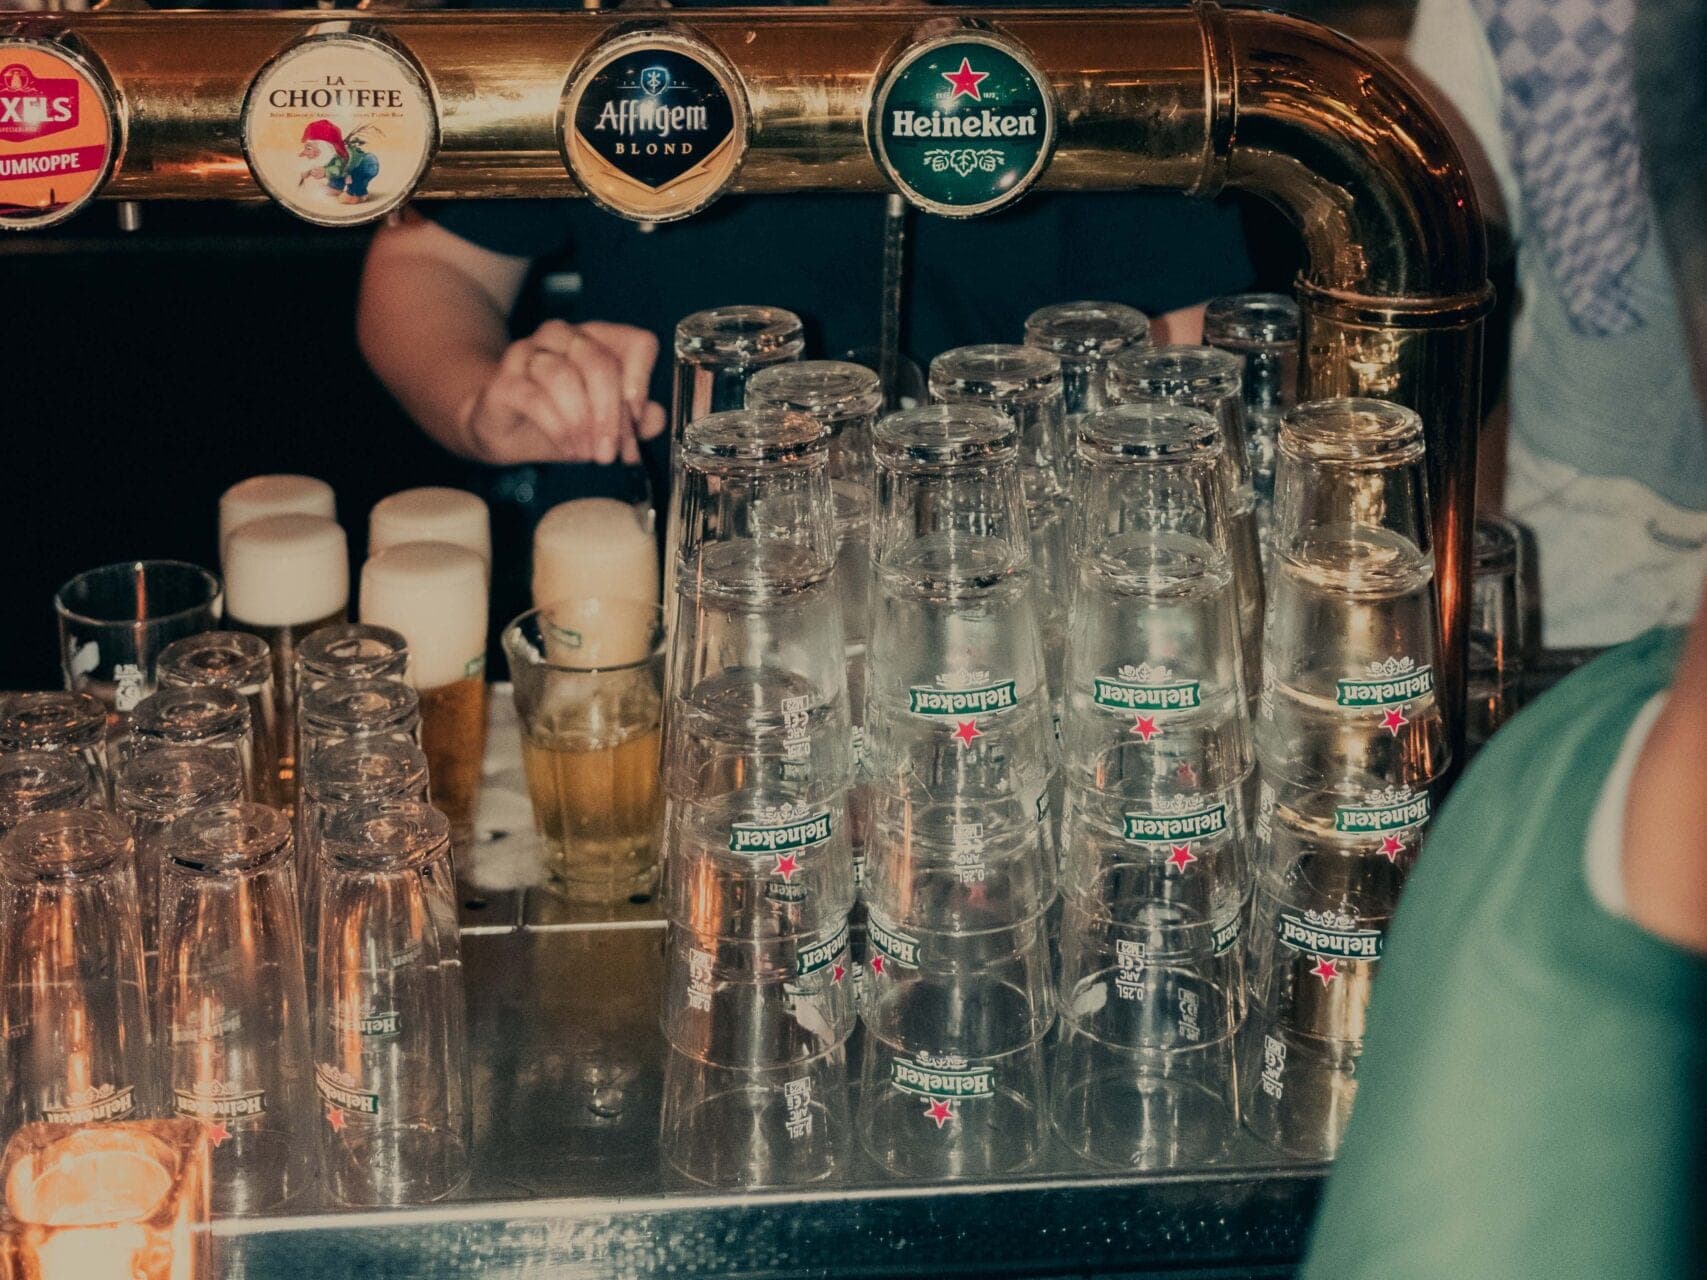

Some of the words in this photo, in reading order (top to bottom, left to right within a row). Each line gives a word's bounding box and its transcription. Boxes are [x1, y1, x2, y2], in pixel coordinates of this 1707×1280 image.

[326, 75, 346, 86] LA
[269, 88, 403, 108] CHOUFFE
[892, 109, 1038, 138] Heineken
[615, 142, 693, 155] BLOND
[915, 685, 1013, 714] Heineken
[1099, 683, 1195, 708] Heineken
[1344, 672, 1430, 704] Heineken
[1130, 810, 1223, 839] Heineken
[1342, 798, 1428, 830] Heineken
[735, 818, 829, 850] Heineken
[1283, 923, 1377, 955] Heineken
[1120, 970, 1140, 982] ARC
[1116, 984, 1144, 1000] 0.25L
[894, 1064, 990, 1095] Heineken
